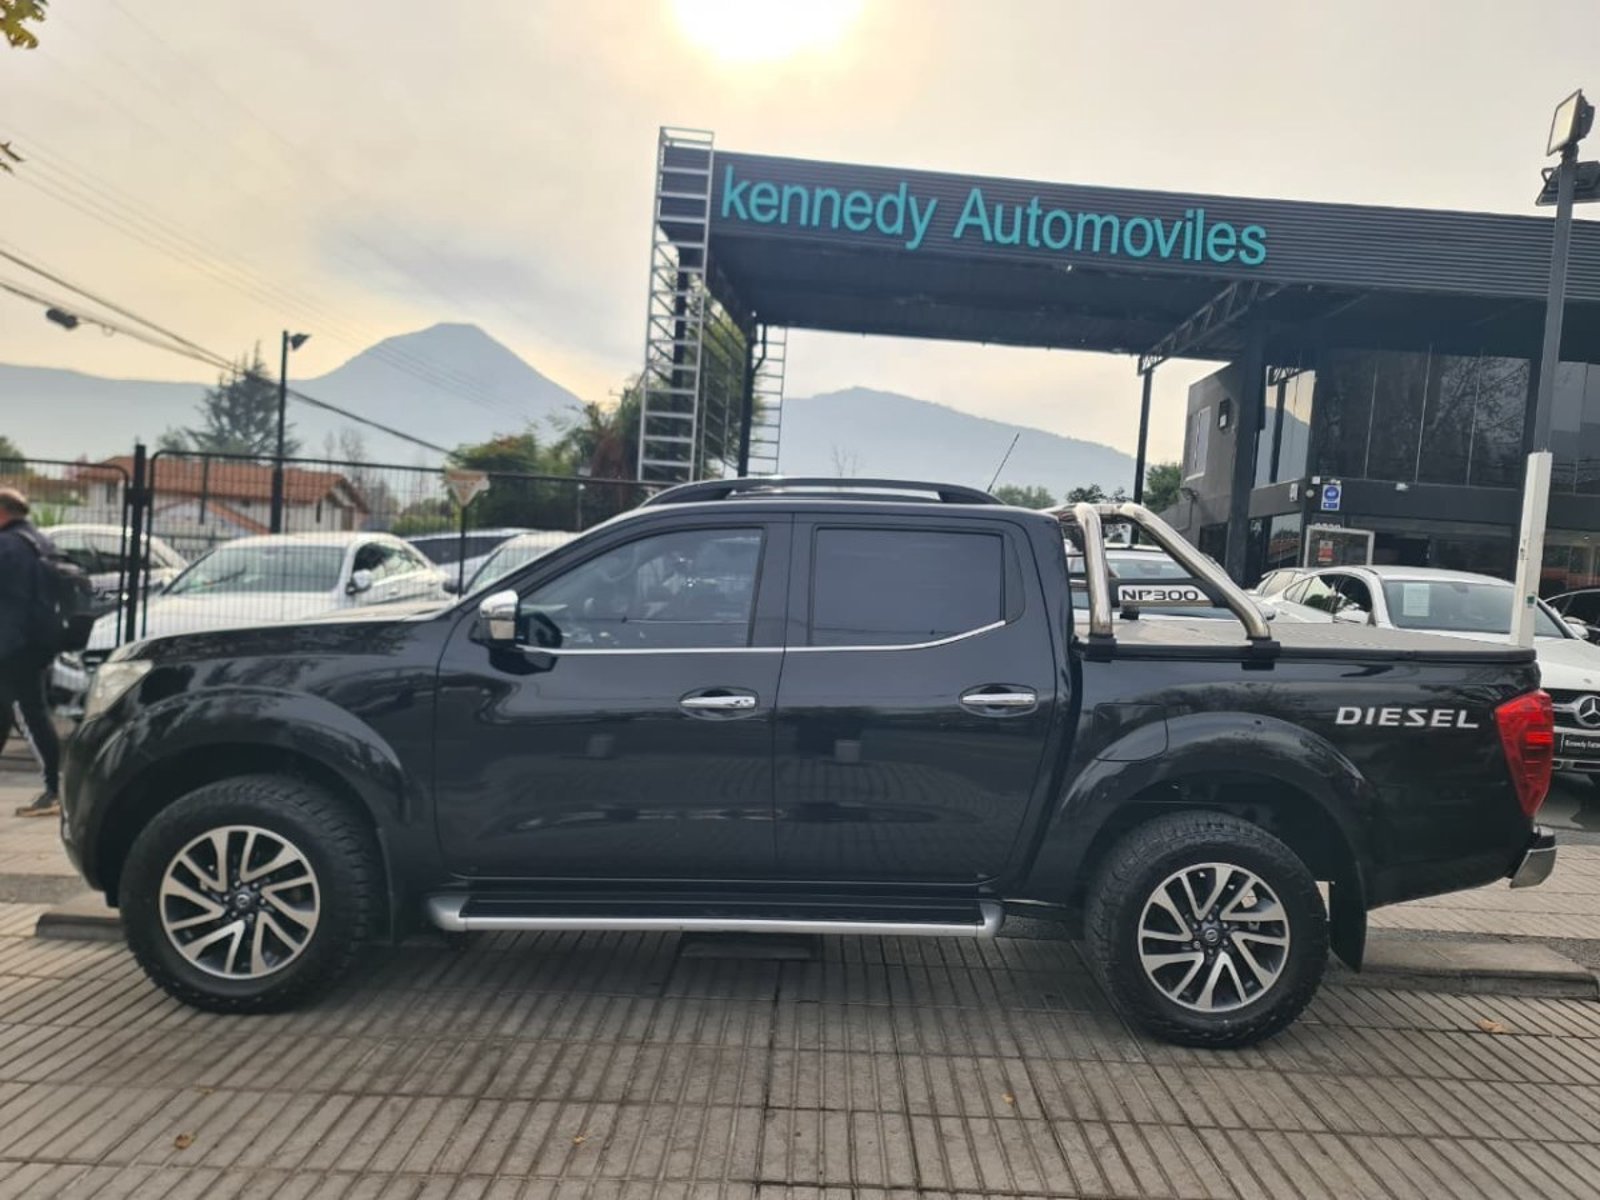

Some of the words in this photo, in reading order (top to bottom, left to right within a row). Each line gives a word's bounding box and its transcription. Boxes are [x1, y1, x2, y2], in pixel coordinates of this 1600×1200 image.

[721, 165, 937, 250] kennedy
[953, 188, 1267, 265] Automoviles
[1122, 590, 1199, 601] NP300
[1335, 706, 1479, 729] DIESEL
